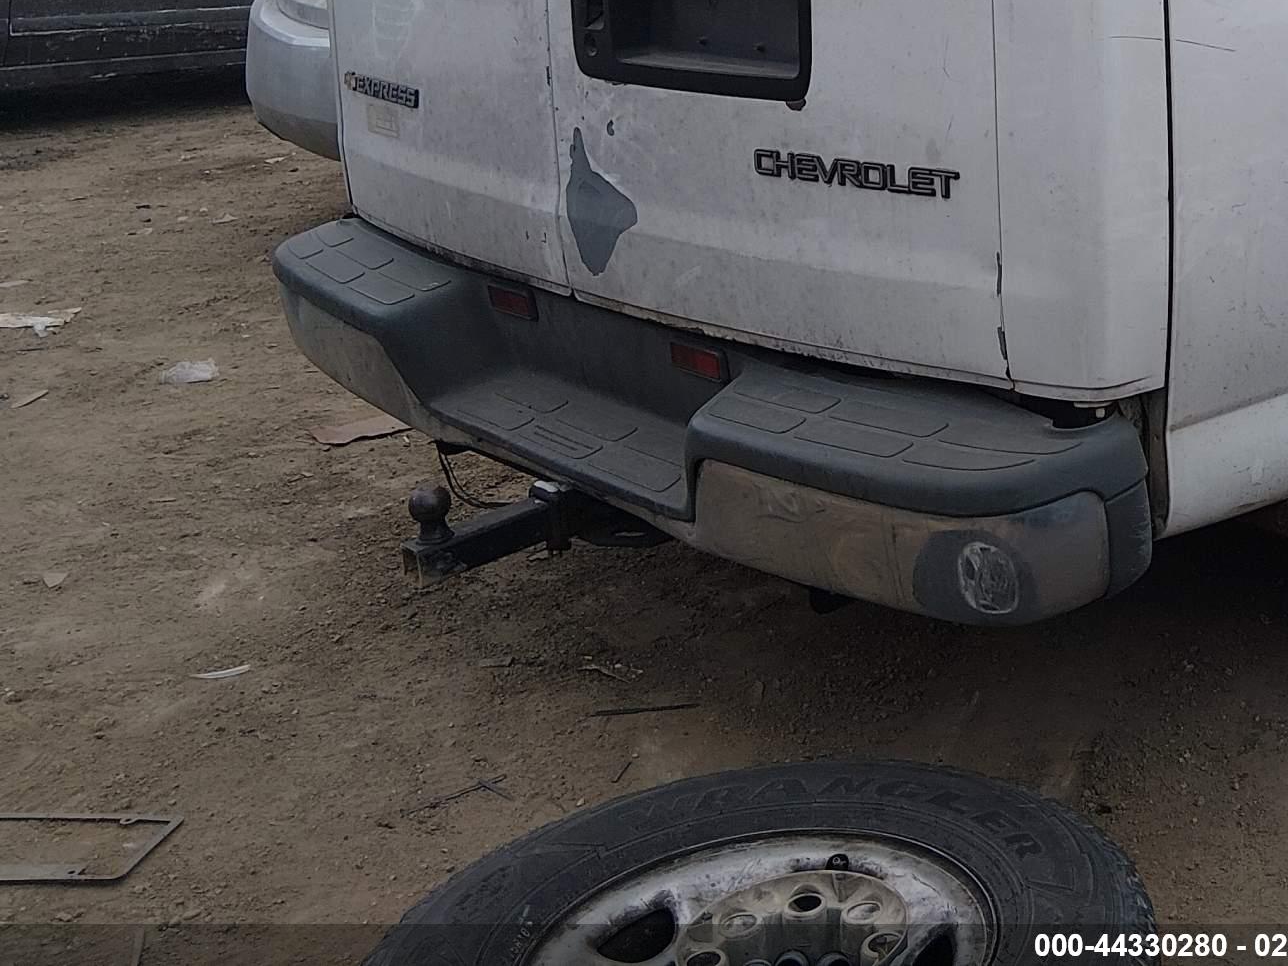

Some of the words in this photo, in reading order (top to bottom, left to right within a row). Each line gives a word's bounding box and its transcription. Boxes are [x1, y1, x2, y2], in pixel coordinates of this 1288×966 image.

[356, 75, 418, 108] EXPRESS
[753, 148, 960, 199] CHEVROLET
[617, 776, 1046, 858] WRANGLER
